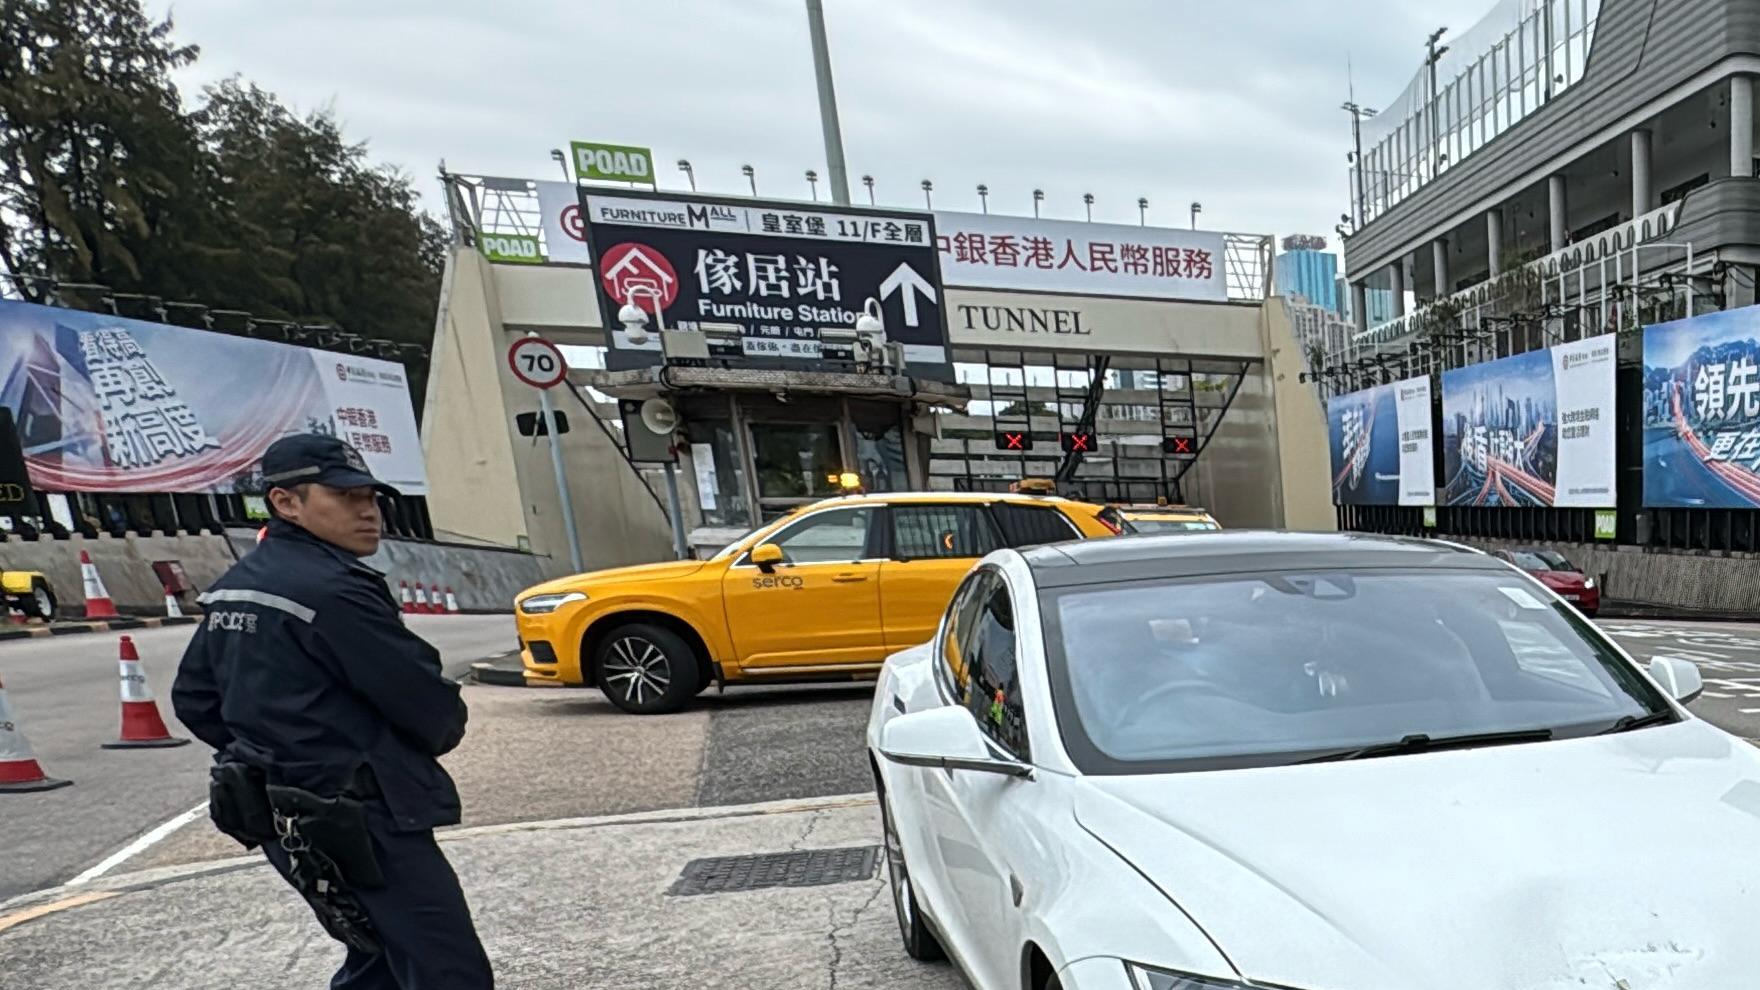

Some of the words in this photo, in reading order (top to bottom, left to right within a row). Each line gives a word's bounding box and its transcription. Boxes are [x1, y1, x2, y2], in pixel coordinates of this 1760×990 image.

[577, 148, 648, 177] POAD
[600, 207, 687, 224] FURNITURE
[762, 213, 828, 236] 皇室堡
[482, 237, 537, 257] POAD
[693, 249, 841, 302] 傢居站
[698, 299, 794, 320] Furniture
[958, 305, 1091, 335] TUNNEL
[521, 354, 554, 372] 70
[752, 575, 803, 589] serco
